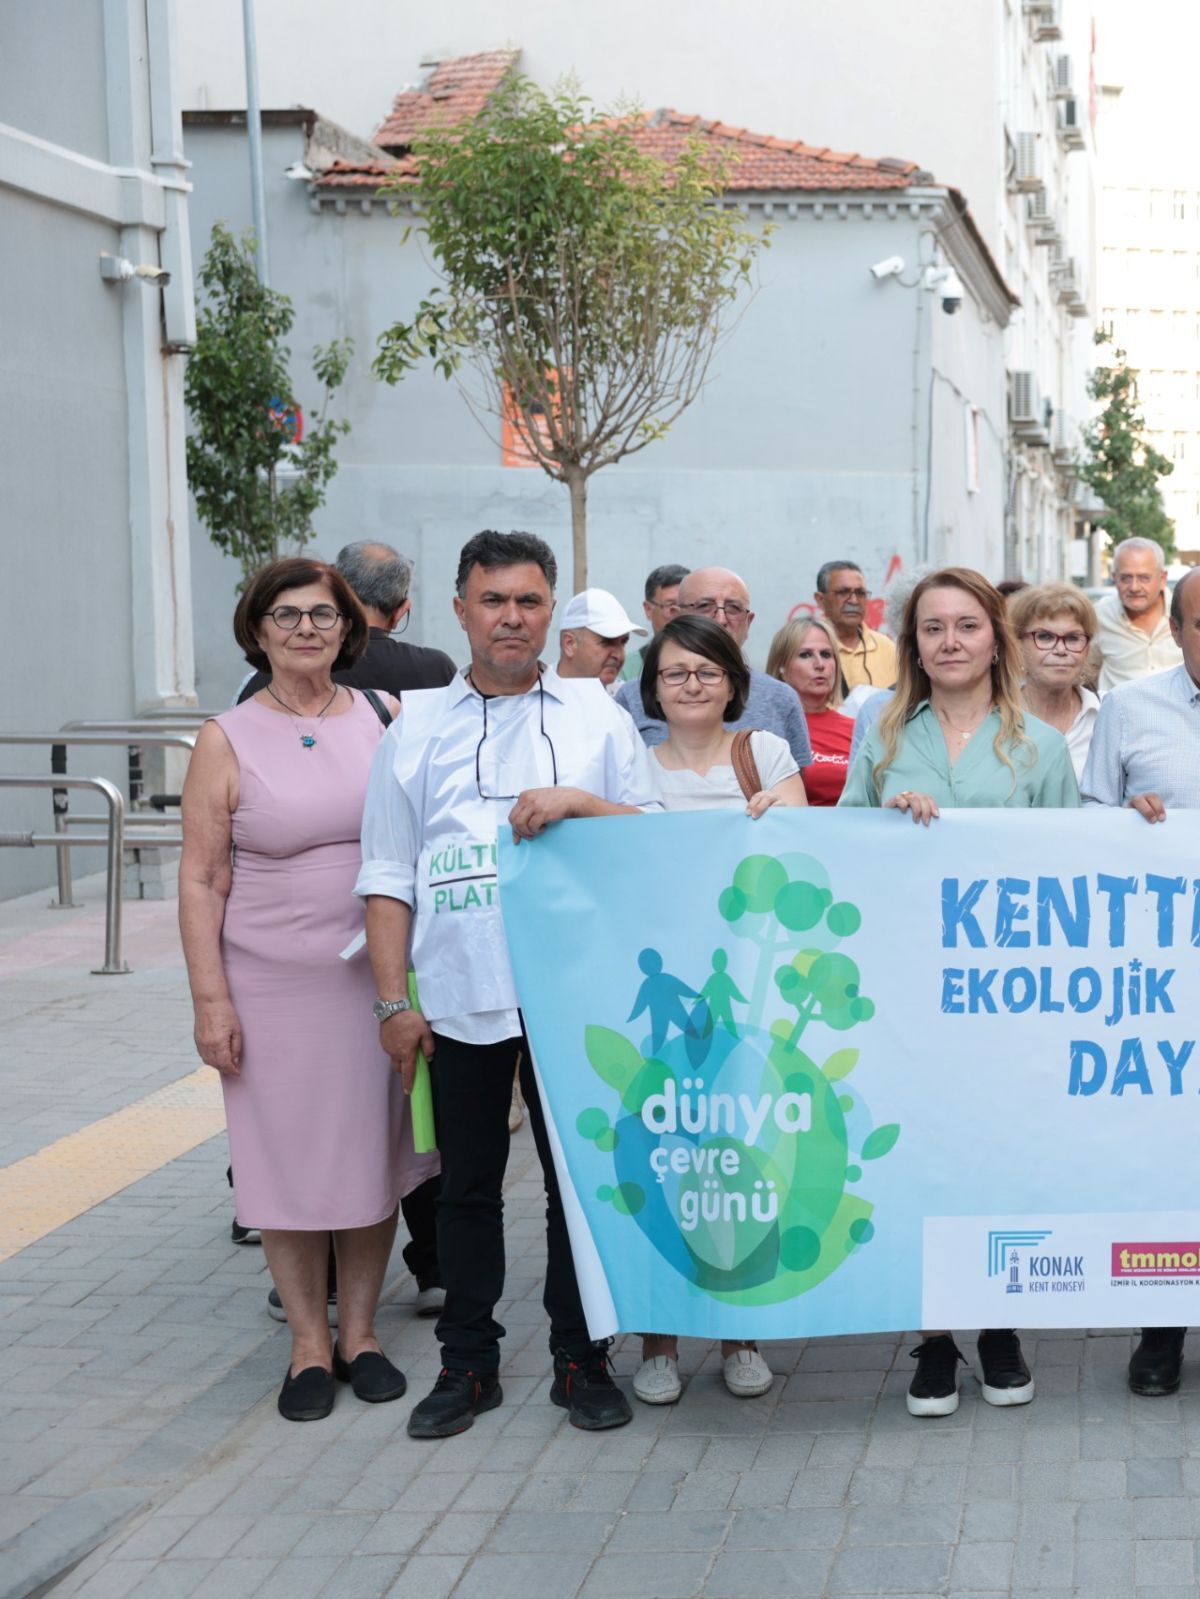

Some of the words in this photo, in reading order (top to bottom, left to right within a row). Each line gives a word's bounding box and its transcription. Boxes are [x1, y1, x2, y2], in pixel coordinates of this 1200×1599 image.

[435, 883, 497, 914] PLAT
[940, 958, 1176, 1027] EKOLOJİK
[641, 1077, 812, 1147] dünya
[650, 1147, 740, 1184] çevre
[680, 1180, 779, 1232] günü
[1029, 1256, 1084, 1277] KONAK
[1029, 1281, 1049, 1293] KENT
[1051, 1279, 1085, 1293] KONSEYİ
